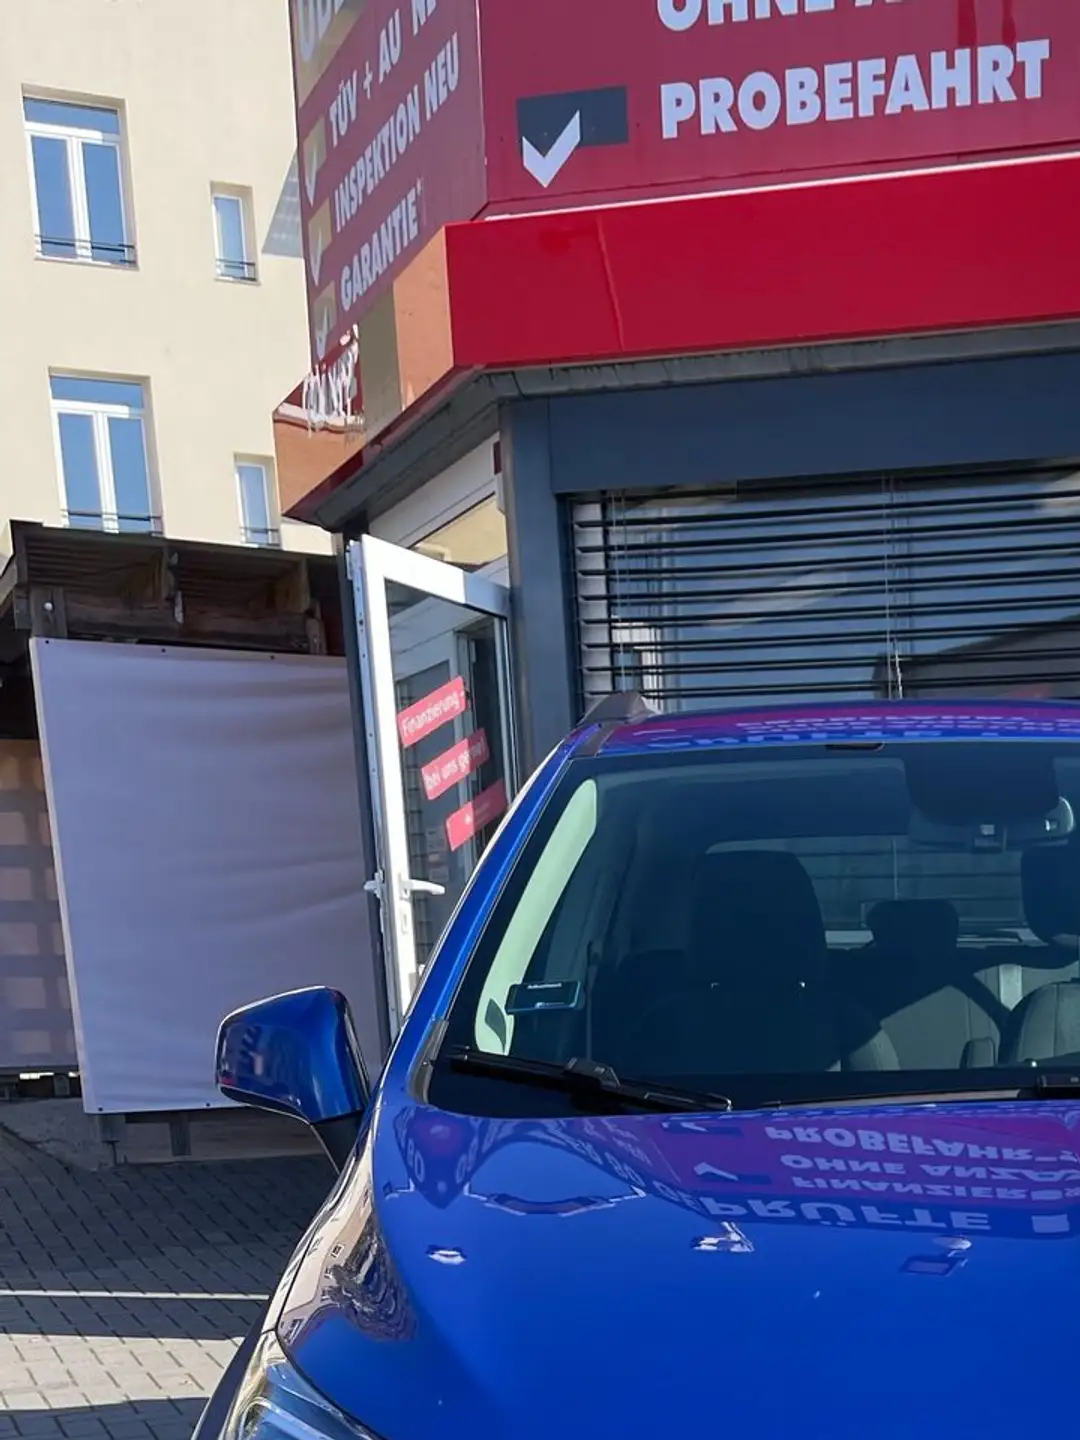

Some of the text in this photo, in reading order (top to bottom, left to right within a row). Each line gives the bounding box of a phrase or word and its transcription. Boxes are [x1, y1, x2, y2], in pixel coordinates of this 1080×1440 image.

[329, 69, 358, 148] TÜV
[379, 8, 401, 84] AU
[335, 31, 459, 233] INSPEKTION NEU
[661, 39, 1050, 139] PROBEFAHRT
